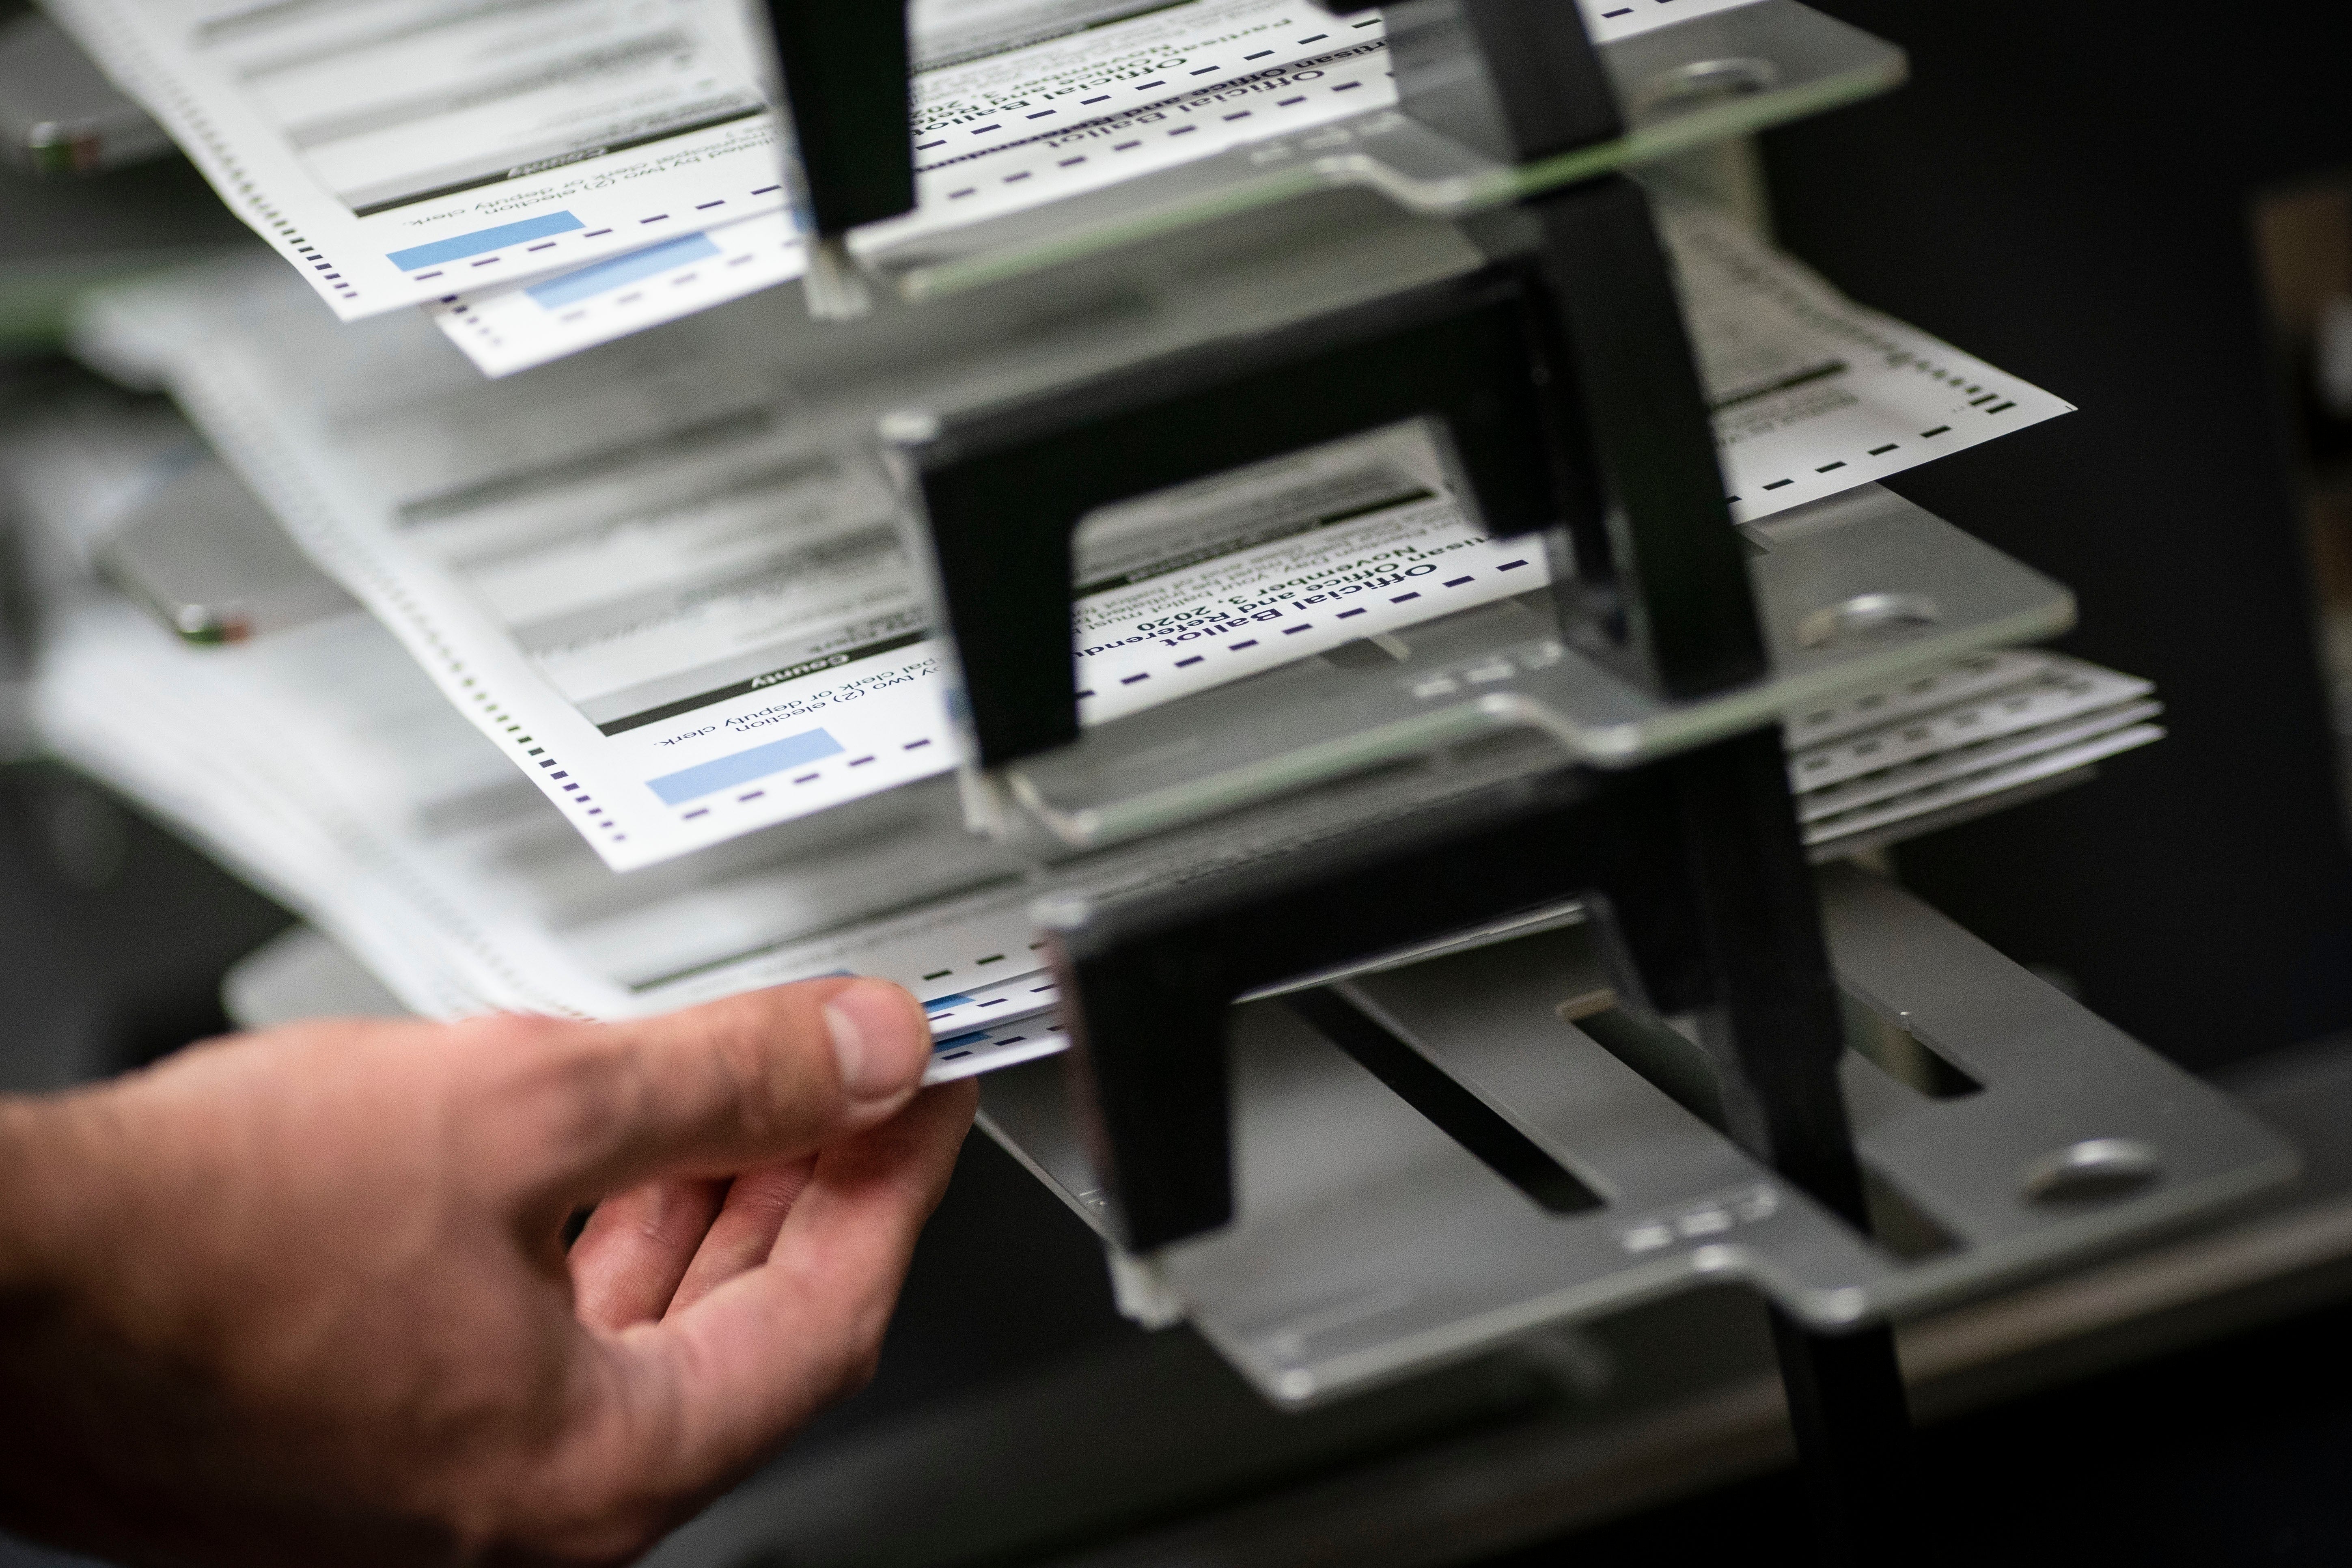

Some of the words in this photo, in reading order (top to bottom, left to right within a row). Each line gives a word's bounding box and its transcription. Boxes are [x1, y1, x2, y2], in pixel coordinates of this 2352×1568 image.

[1295, 40, 1385, 68] rtisan
[1043, 59, 1186, 99] Official
[1060, 59, 1151, 84] Office
[1192, 69, 1285, 95] Office
[990, 87, 1045, 105] and
[1178, 71, 1324, 112] Official
[907, 100, 1030, 136] Ballot
[908, 100, 962, 121] 202
[1123, 97, 1180, 116] and
[1044, 112, 1166, 147] Ballot
[584, 178, 614, 190] (2)
[485, 189, 575, 214] election
[1407, 537, 1487, 562] tisan
[1259, 546, 1417, 596] November
[1306, 564, 1398, 591] Office
[1218, 595, 1248, 604] 3,
[1291, 564, 1436, 610] Official
[1151, 591, 1212, 613] ballot
[1237, 592, 1295, 613] and
[1088, 612, 1142, 630] must
[1137, 606, 1210, 631] 2020
[1159, 608, 1283, 647] Ballot
[1071, 612, 1230, 656] Referendu
[752, 654, 849, 688] County
[838, 671, 894, 689] clerk
[873, 675, 914, 688] two
[811, 690, 832, 701] or
[833, 689, 864, 702] (2)
[725, 700, 801, 727] deputy
[735, 702, 825, 732] election
[653, 726, 715, 745] clerk.
